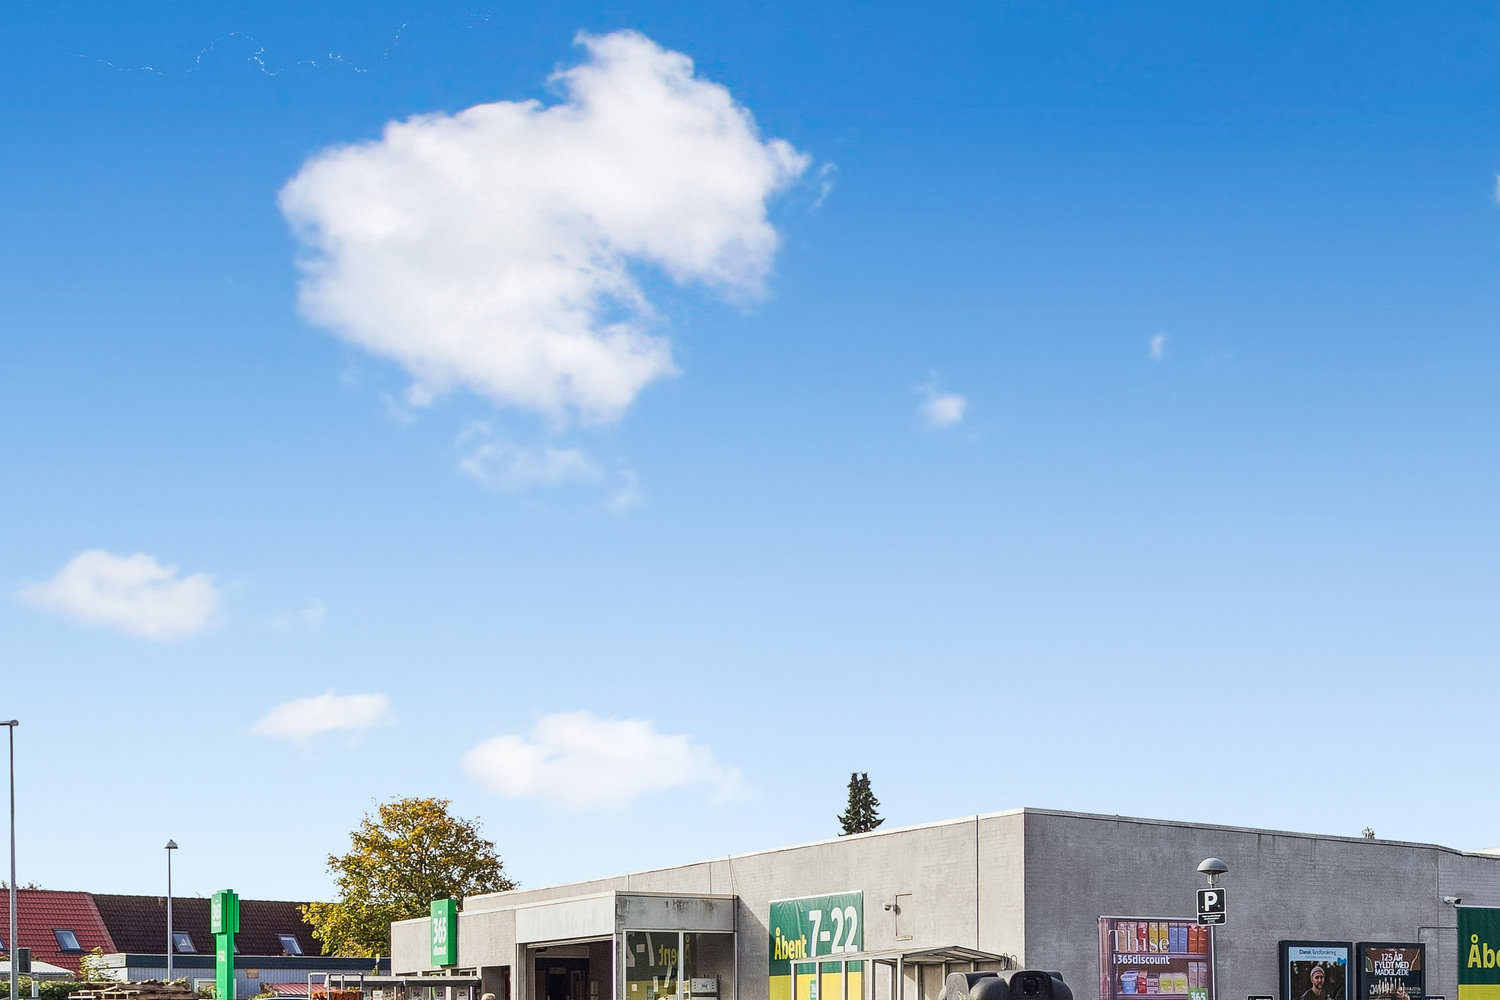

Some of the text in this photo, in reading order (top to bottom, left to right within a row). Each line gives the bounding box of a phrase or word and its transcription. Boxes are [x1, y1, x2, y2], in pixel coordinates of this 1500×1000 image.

[1204, 891, 1218, 911] P
[774, 905, 858, 960] Åbent 7-22
[1108, 929, 1170, 952] Thise
[1118, 954, 1171, 965] 365discount
[1381, 951, 1404, 961] 125 ÅR
[1374, 961, 1410, 969] FYLDT MED
[1374, 968, 1410, 976] MADGLÆDE
